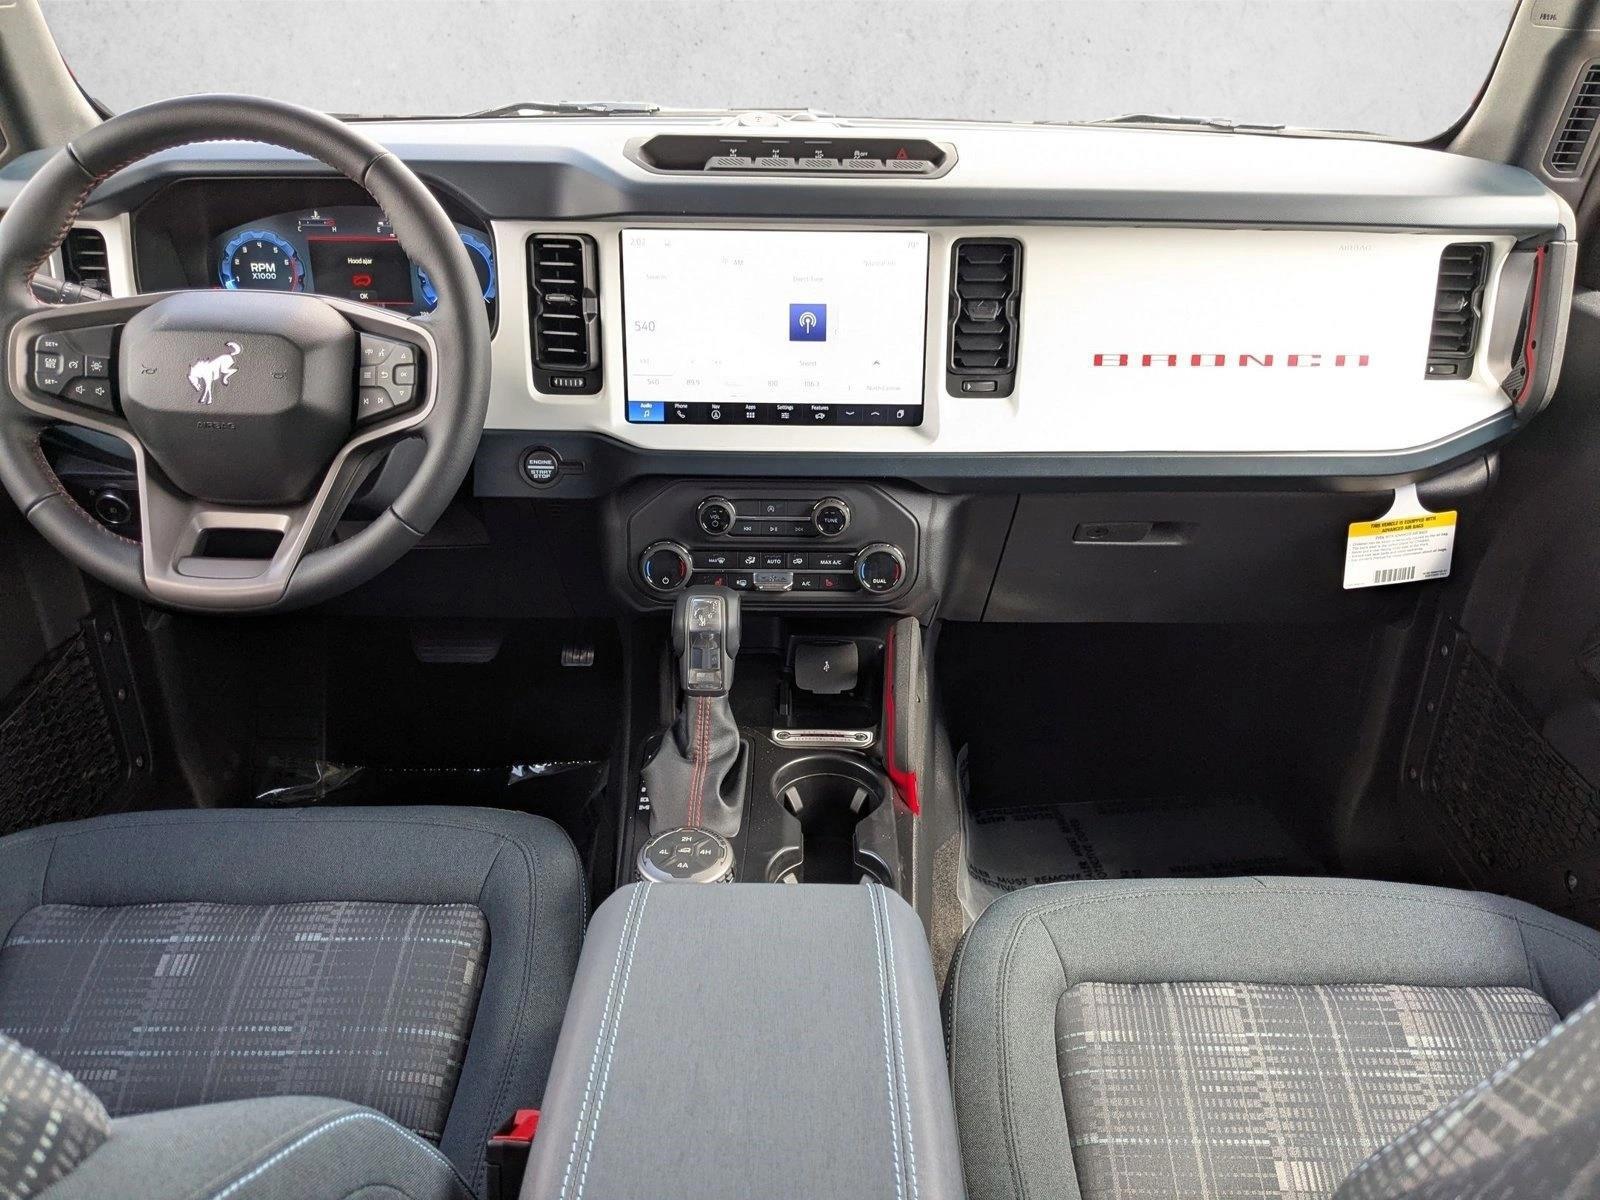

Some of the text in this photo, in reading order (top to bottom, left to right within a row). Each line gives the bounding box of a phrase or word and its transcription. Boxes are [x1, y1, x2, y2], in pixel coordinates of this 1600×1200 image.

[347, 257, 372, 266] Hood ajar
[250, 262, 276, 273] RPM
[252, 272, 277, 280] X1000
[634, 320, 656, 332] 540
[1093, 354, 1369, 367] BRONCO
